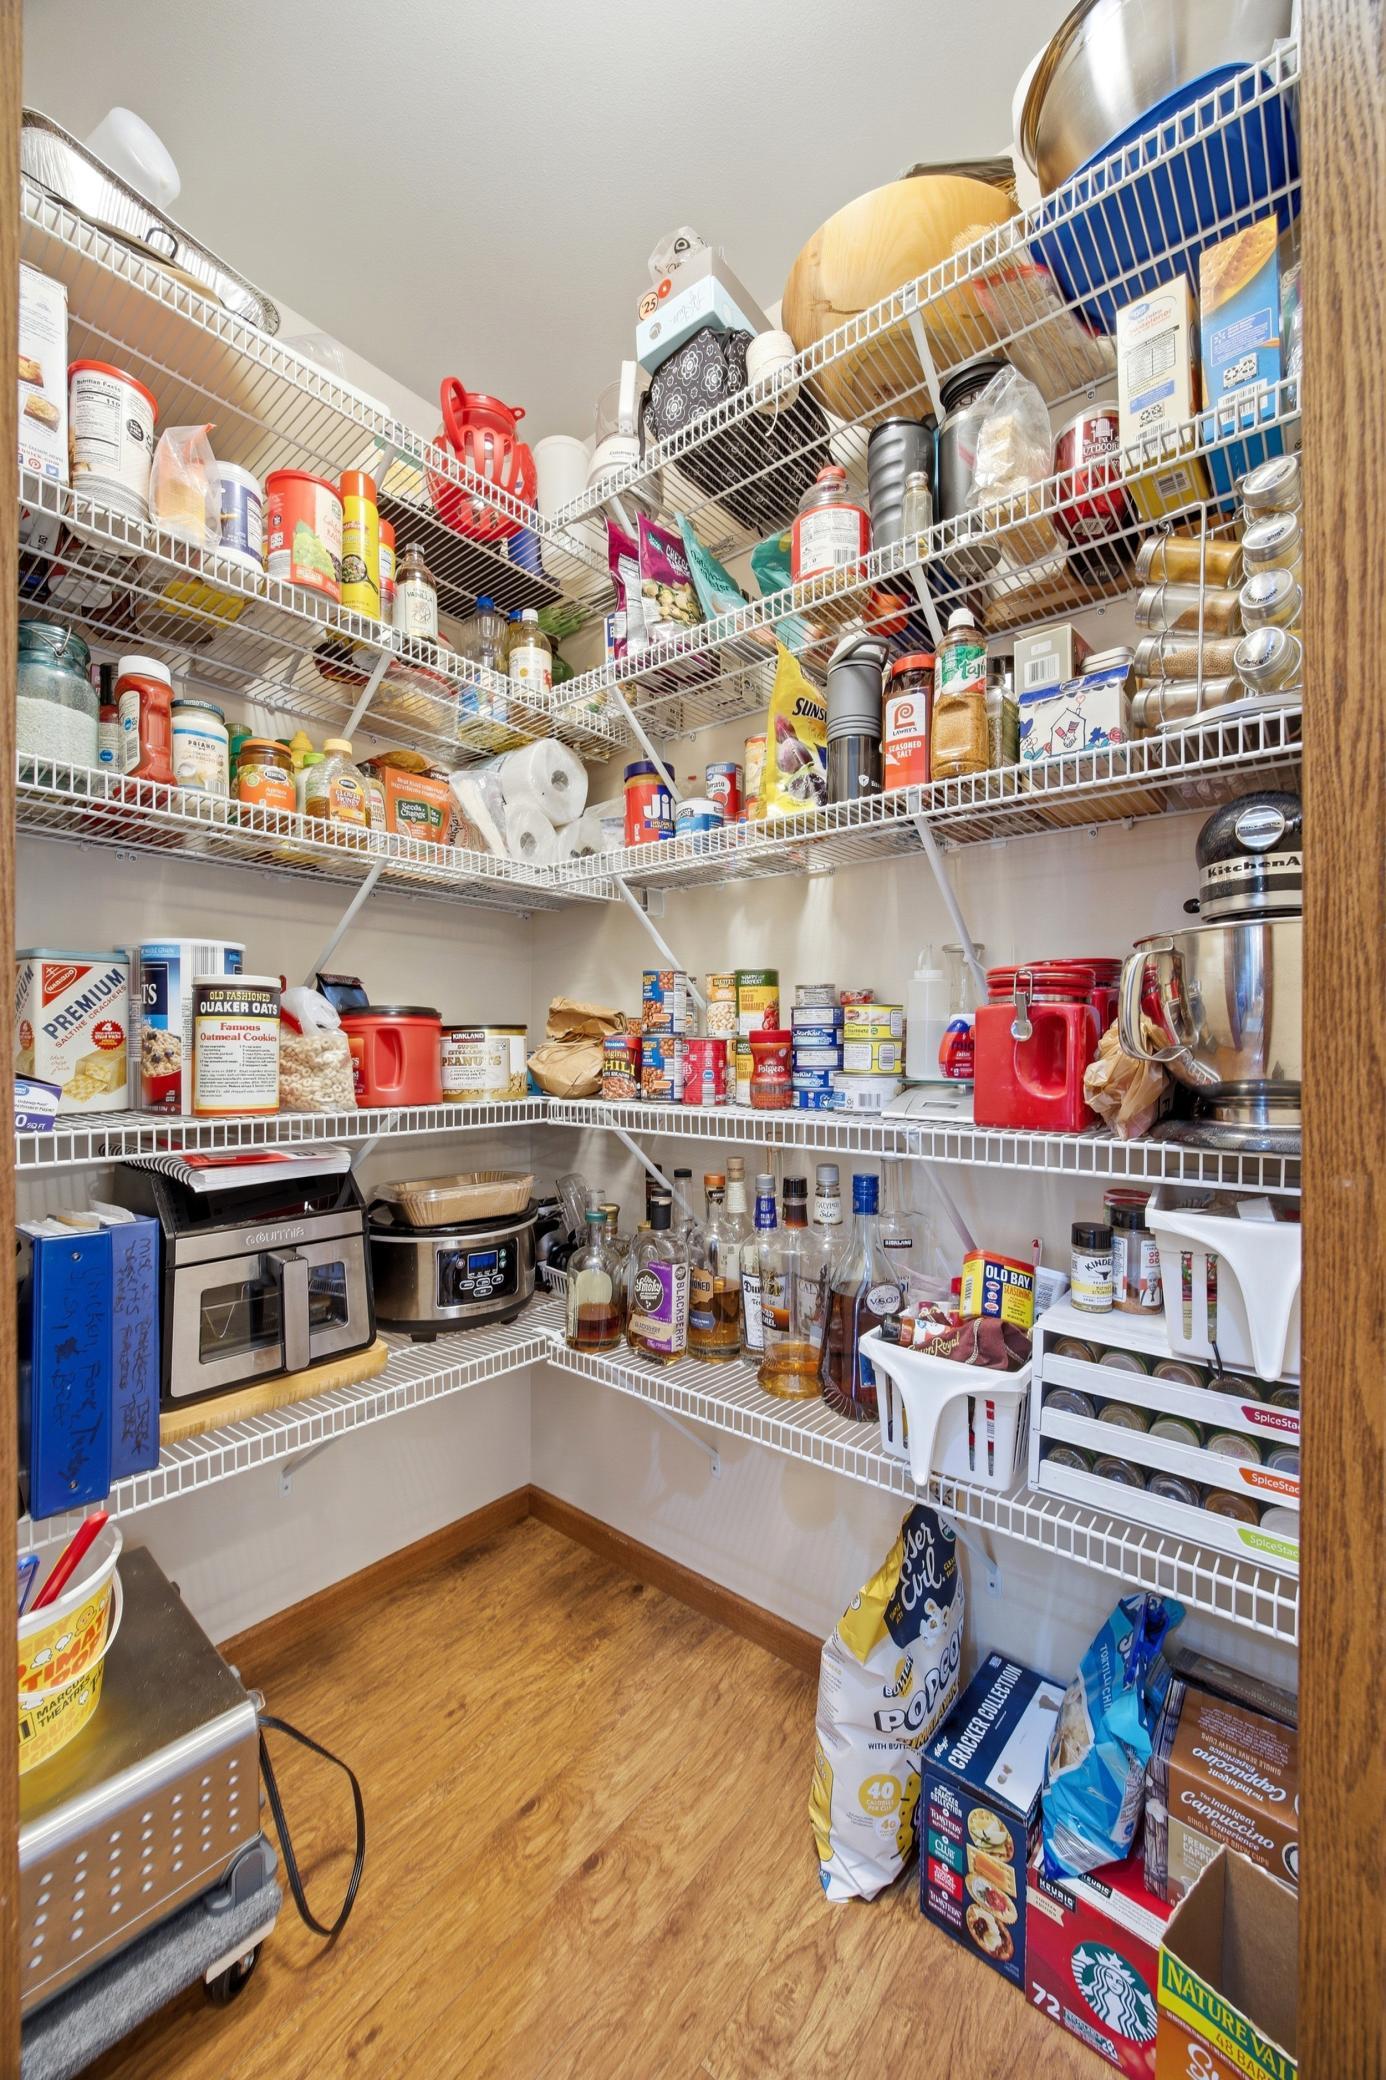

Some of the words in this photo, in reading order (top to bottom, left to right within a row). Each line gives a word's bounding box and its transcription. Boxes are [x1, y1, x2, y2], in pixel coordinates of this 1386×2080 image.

[792, 697, 827, 723] SUNS
[888, 740, 922, 752] SEASONED
[896, 750, 912, 759] SALT
[643, 794, 675, 820] Ji
[47, 969, 75, 994] NABISCO
[42, 968, 125, 1040] PREMIUM
[200, 1001, 249, 1013] QUAKER
[252, 1002, 278, 1015] OATS
[209, 991, 224, 1000] OLD
[226, 992, 271, 1003] FASHIONED
[55, 1020, 88, 1049] SALTINE
[88, 985, 127, 1019] CRACKERS
[220, 1022, 261, 1031] Famous
[200, 1032, 241, 1042] Oatmeal
[243, 1033, 277, 1042] Cookies
[758, 1064, 785, 1075] Folgers
[985, 1264, 1008, 1282] OLD
[1010, 1272, 1030, 1288] BAY
[1003, 1284, 1031, 1301] SEASONING
[675, 1281, 685, 1348] BLACKBERRY
[932, 1330, 960, 1357] Royal
[884, 1655, 914, 1698] BUTTER
[948, 1715, 991, 1770] CRACKER
[978, 1663, 1023, 1721] COLLECTION
[868, 1743, 887, 1751] WITH
[1192, 1747, 1286, 1802] Cappuccino
[1208, 1767, 1252, 1797] Indulgent
[867, 1781, 894, 1799] 40
[1180, 1791, 1275, 1850] Cappuccino
[1200, 1791, 1211, 1802] The
[1211, 1797, 1256, 1827] Indulgent
[1187, 1816, 1209, 1834] SINGLE
[1209, 1829, 1230, 1845] SERVE
[1231, 1840, 1249, 1855] BREW
[1211, 1820, 1260, 1851] Experience
[1039, 1878, 1074, 1909] KEURIG
[1031, 1981, 1060, 2021] 72
[1167, 1959, 1247, 2046] NATURE
[1216, 2034, 1234, 2057] 48
